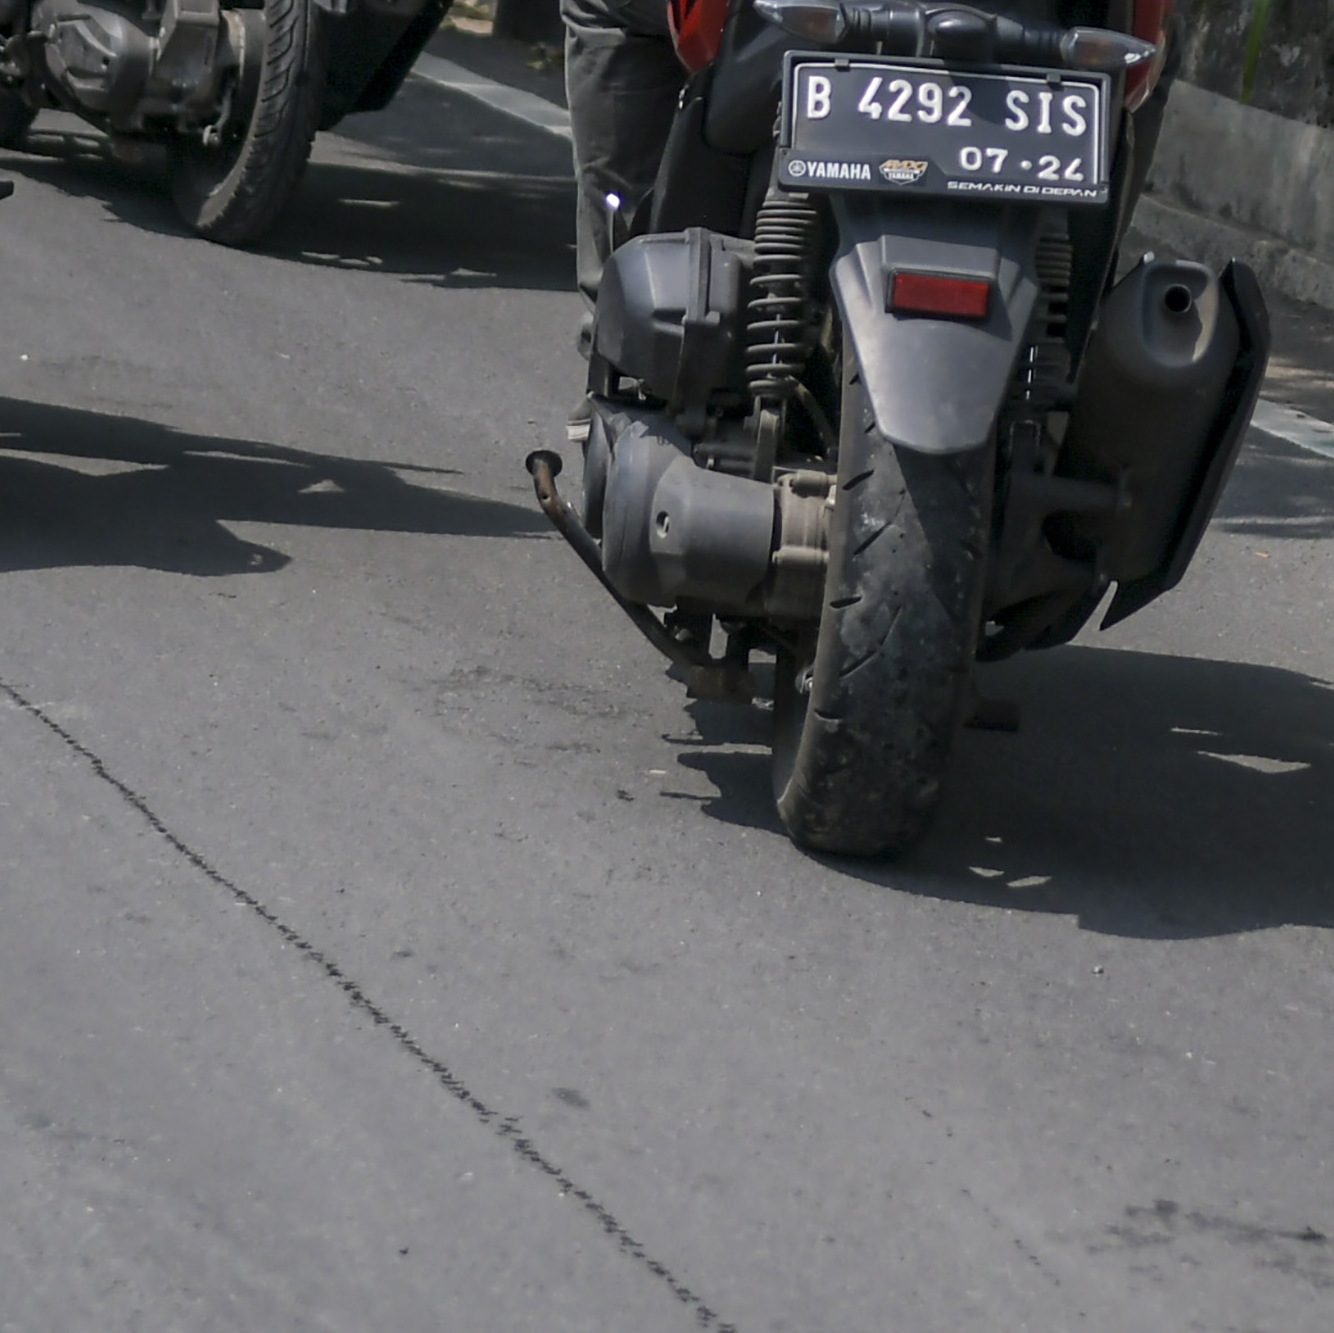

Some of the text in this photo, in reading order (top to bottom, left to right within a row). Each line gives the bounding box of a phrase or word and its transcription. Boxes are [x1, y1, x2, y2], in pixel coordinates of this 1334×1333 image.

[807, 75, 1087, 136] B 4292 SIS
[807, 161, 872, 180] YAMAHA
[1042, 188, 1097, 197] DEPAN
